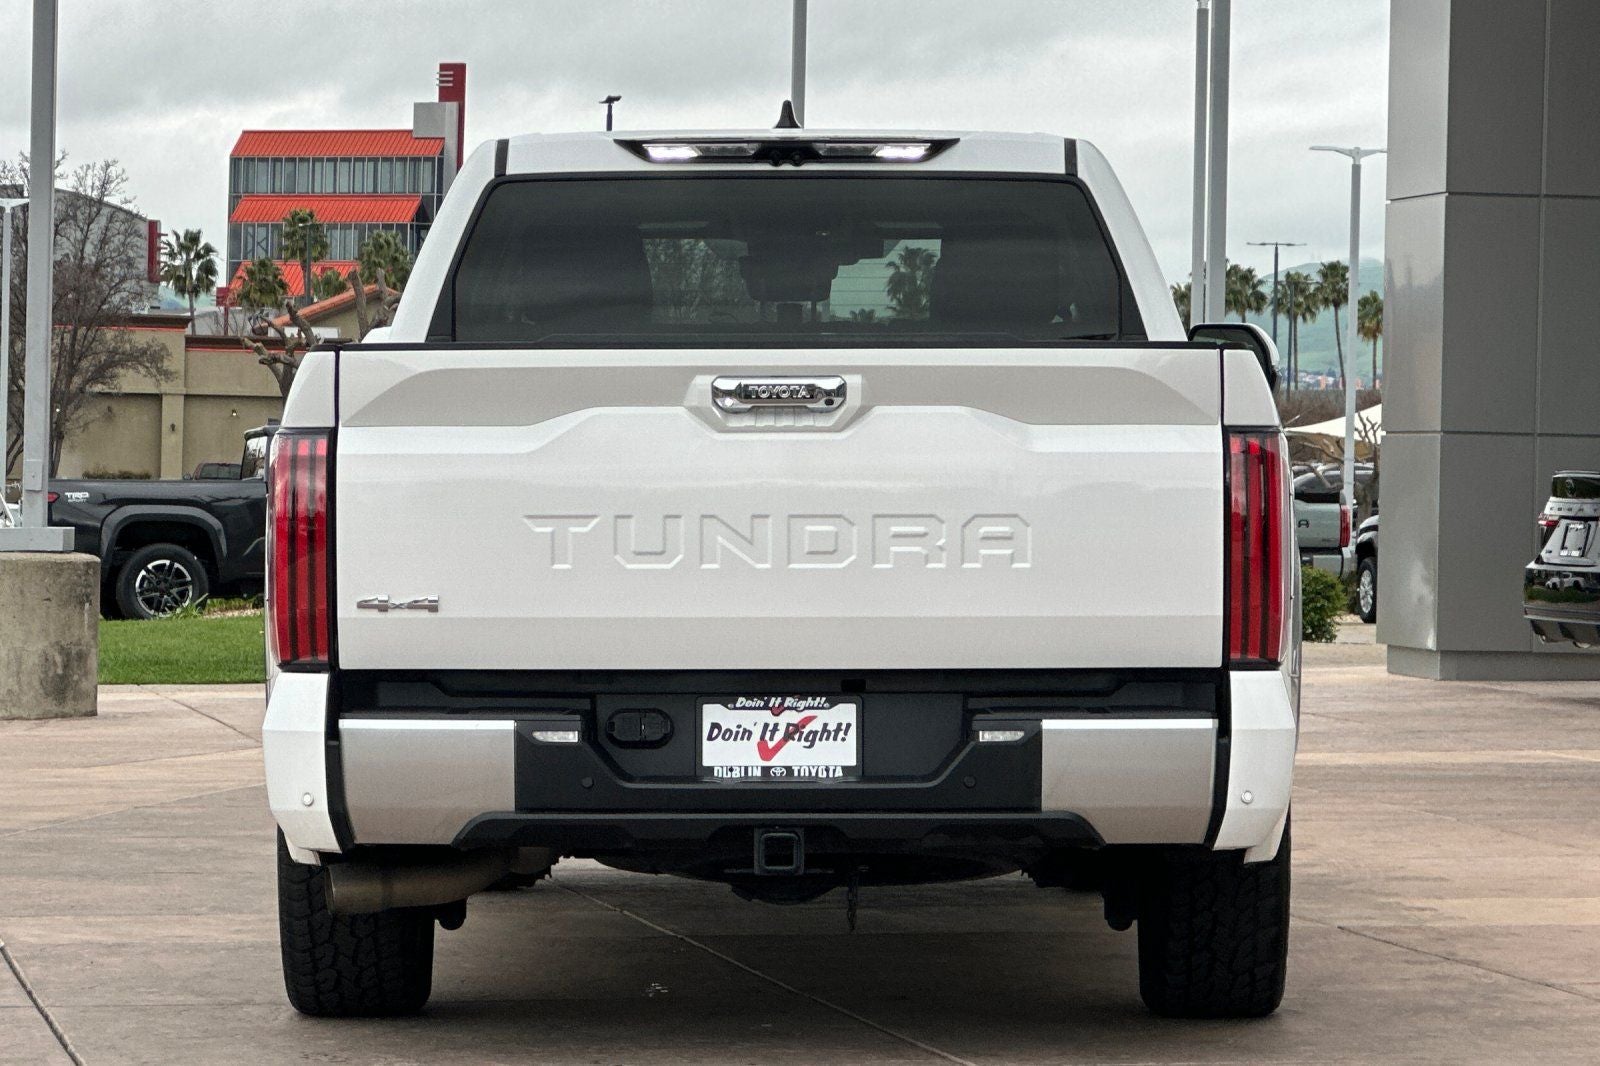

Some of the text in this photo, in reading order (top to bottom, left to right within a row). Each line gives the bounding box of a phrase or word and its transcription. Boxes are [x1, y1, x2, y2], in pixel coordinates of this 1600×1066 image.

[748, 386, 811, 398] TOYOTA
[65, 491, 89, 499] TRD
[523, 514, 1033, 569] TUNDRA
[736, 696, 827, 710] Doin' It Right!
[706, 722, 852, 749] Doin' It Right!
